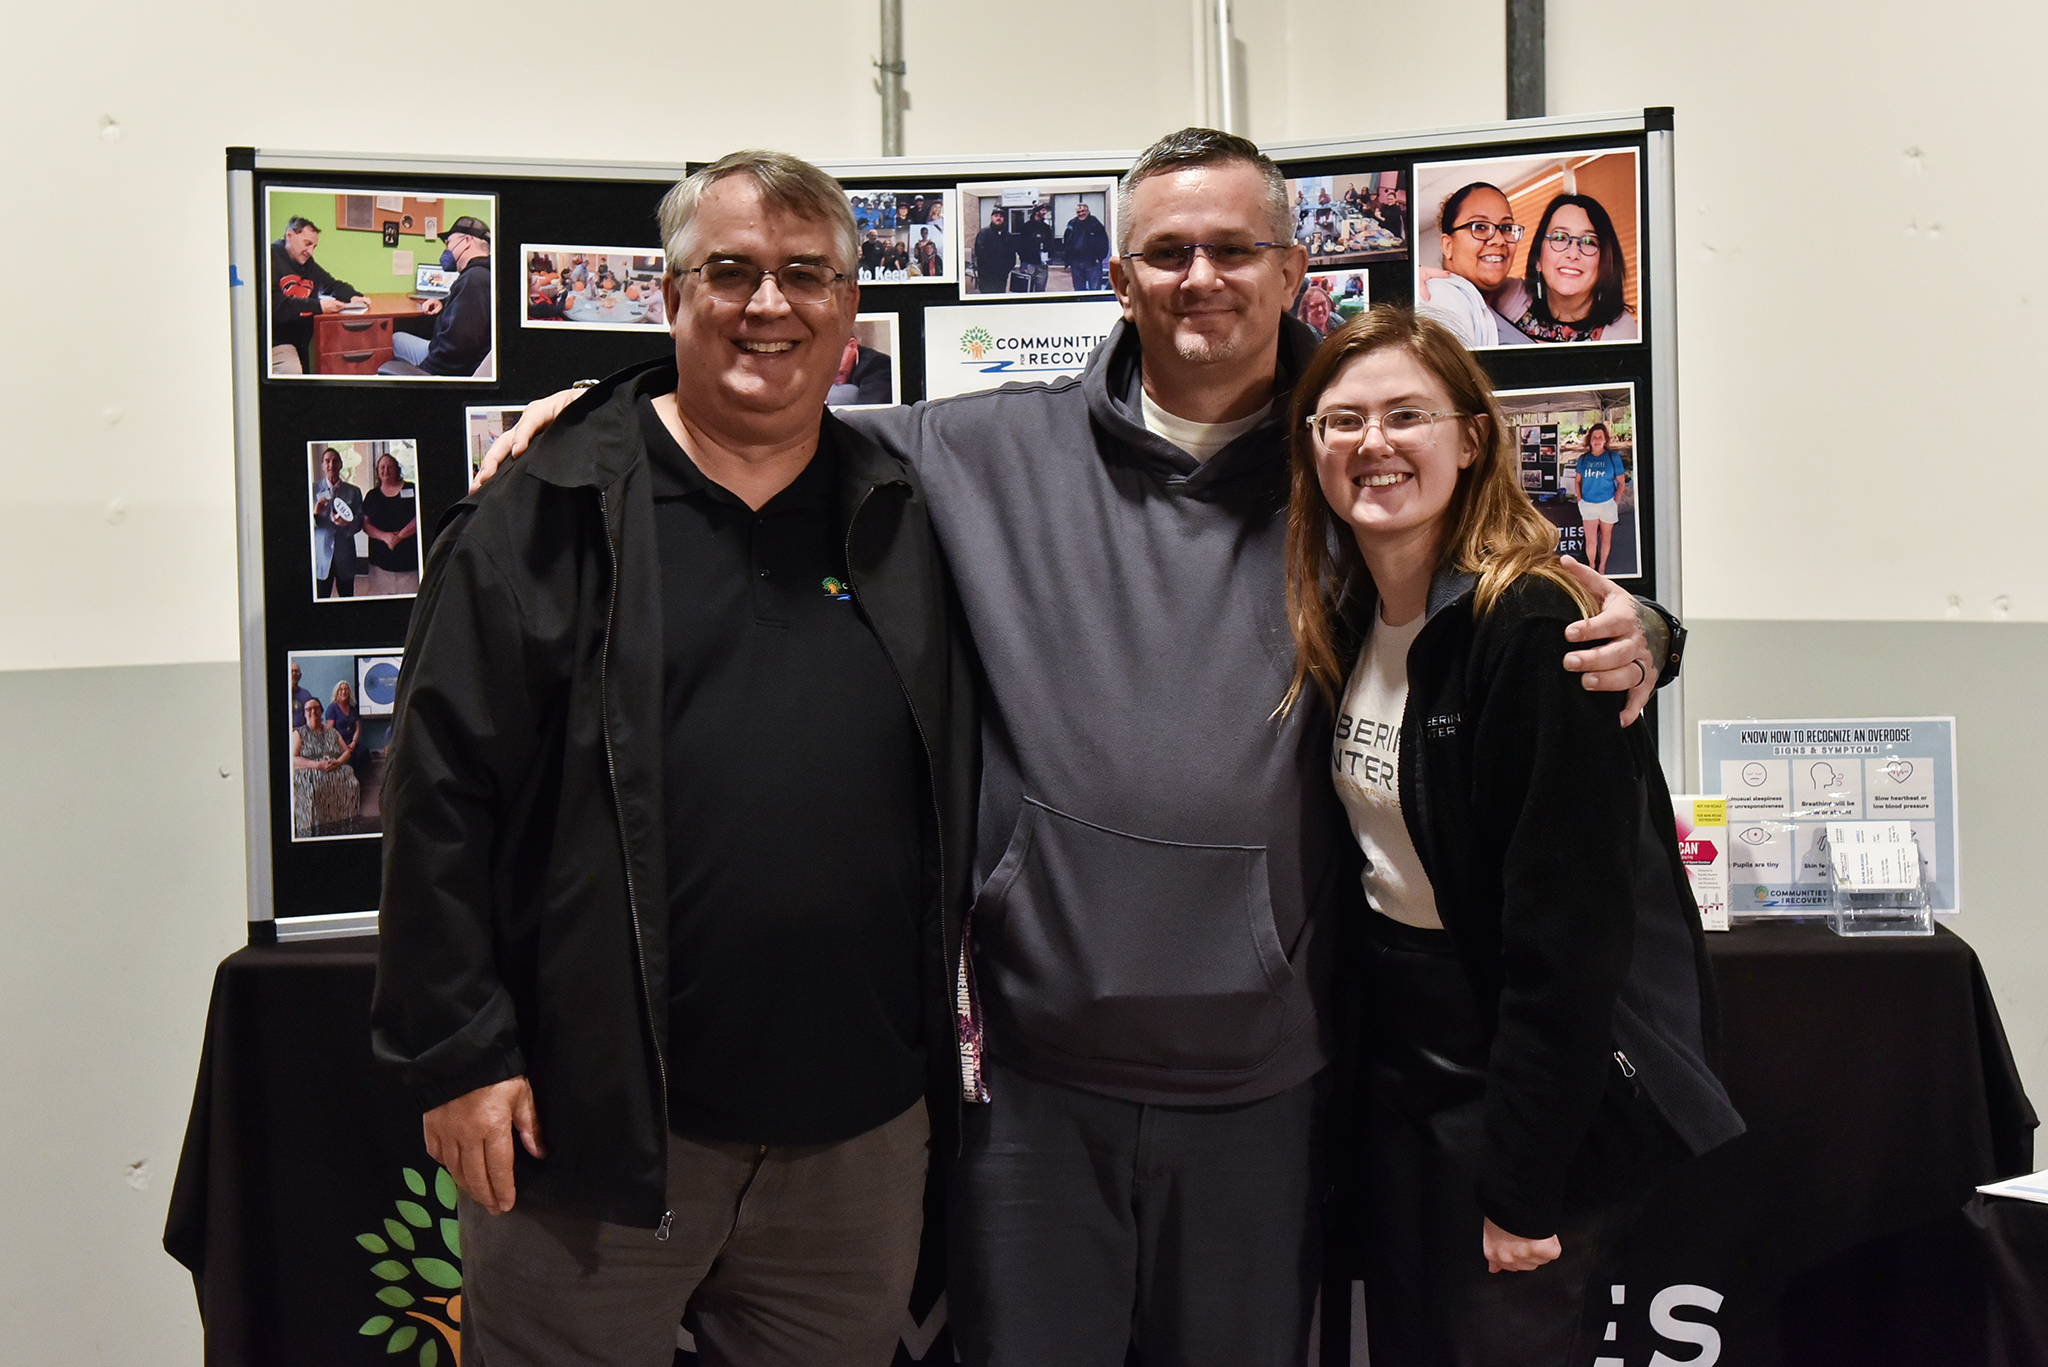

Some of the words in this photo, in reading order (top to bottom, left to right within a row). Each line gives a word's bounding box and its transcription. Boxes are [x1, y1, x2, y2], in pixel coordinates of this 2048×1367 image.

[858, 267, 872, 281] to
[875, 266, 908, 284] Keep
[1029, 352, 1091, 365] RECOV
[336, 502, 350, 517] 182
[1741, 731, 1767, 744] KNOW
[1770, 730, 1790, 743] HOW
[1794, 730, 1804, 743] TO
[1807, 729, 1851, 743] RECOGNIZE
[1854, 729, 1865, 742] AN
[1868, 728, 1911, 742] OVERDOSE
[1821, 745, 1879, 754] SYMPTOMS
[1679, 842, 1698, 855] CAN
